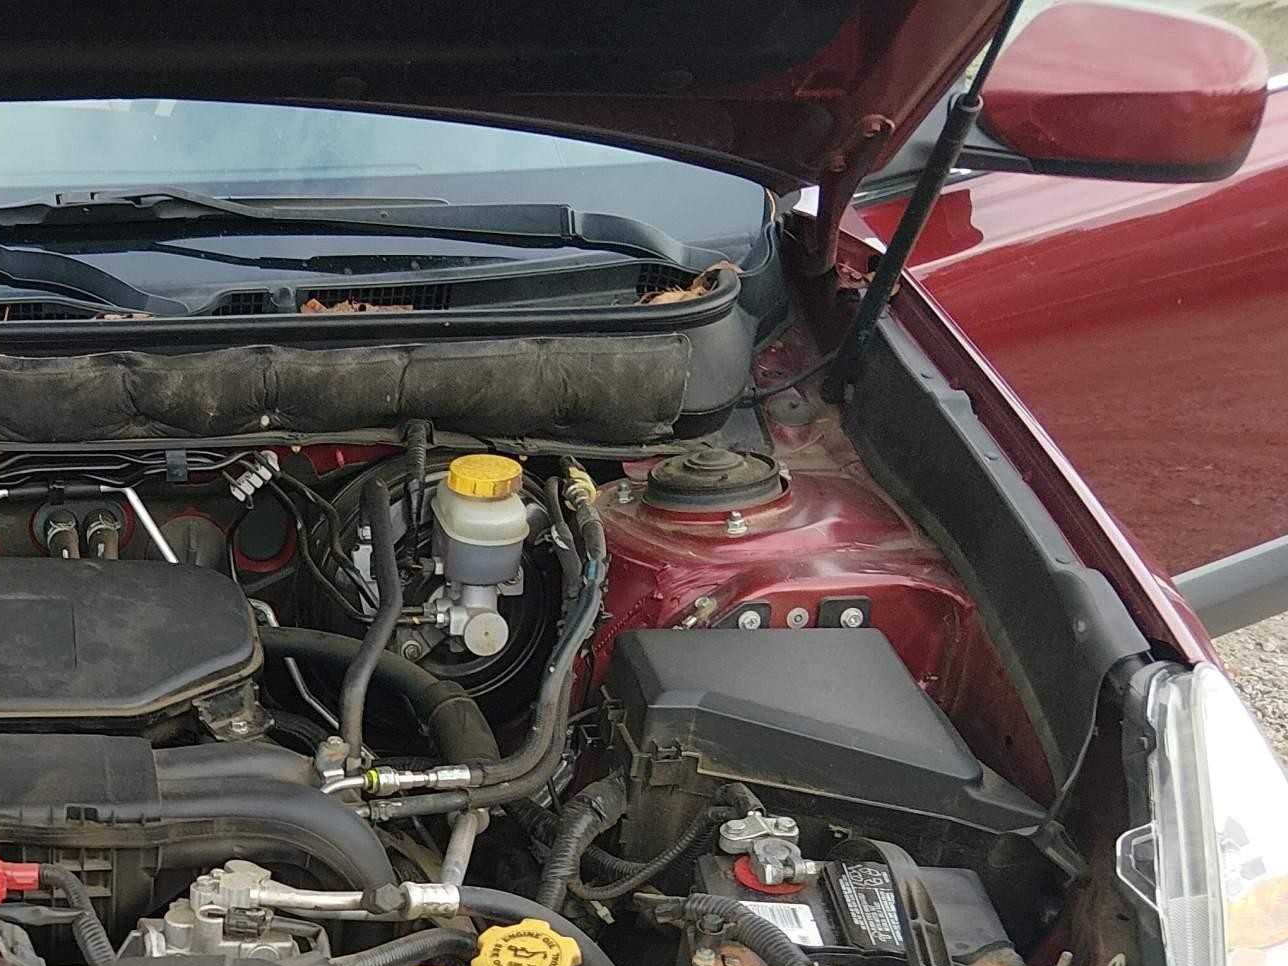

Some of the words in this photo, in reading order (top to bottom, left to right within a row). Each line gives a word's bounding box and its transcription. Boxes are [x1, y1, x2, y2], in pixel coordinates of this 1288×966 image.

[503, 931, 541, 942] ENGINE
[542, 937, 556, 949] OIL
[490, 943, 503, 958] SEE
